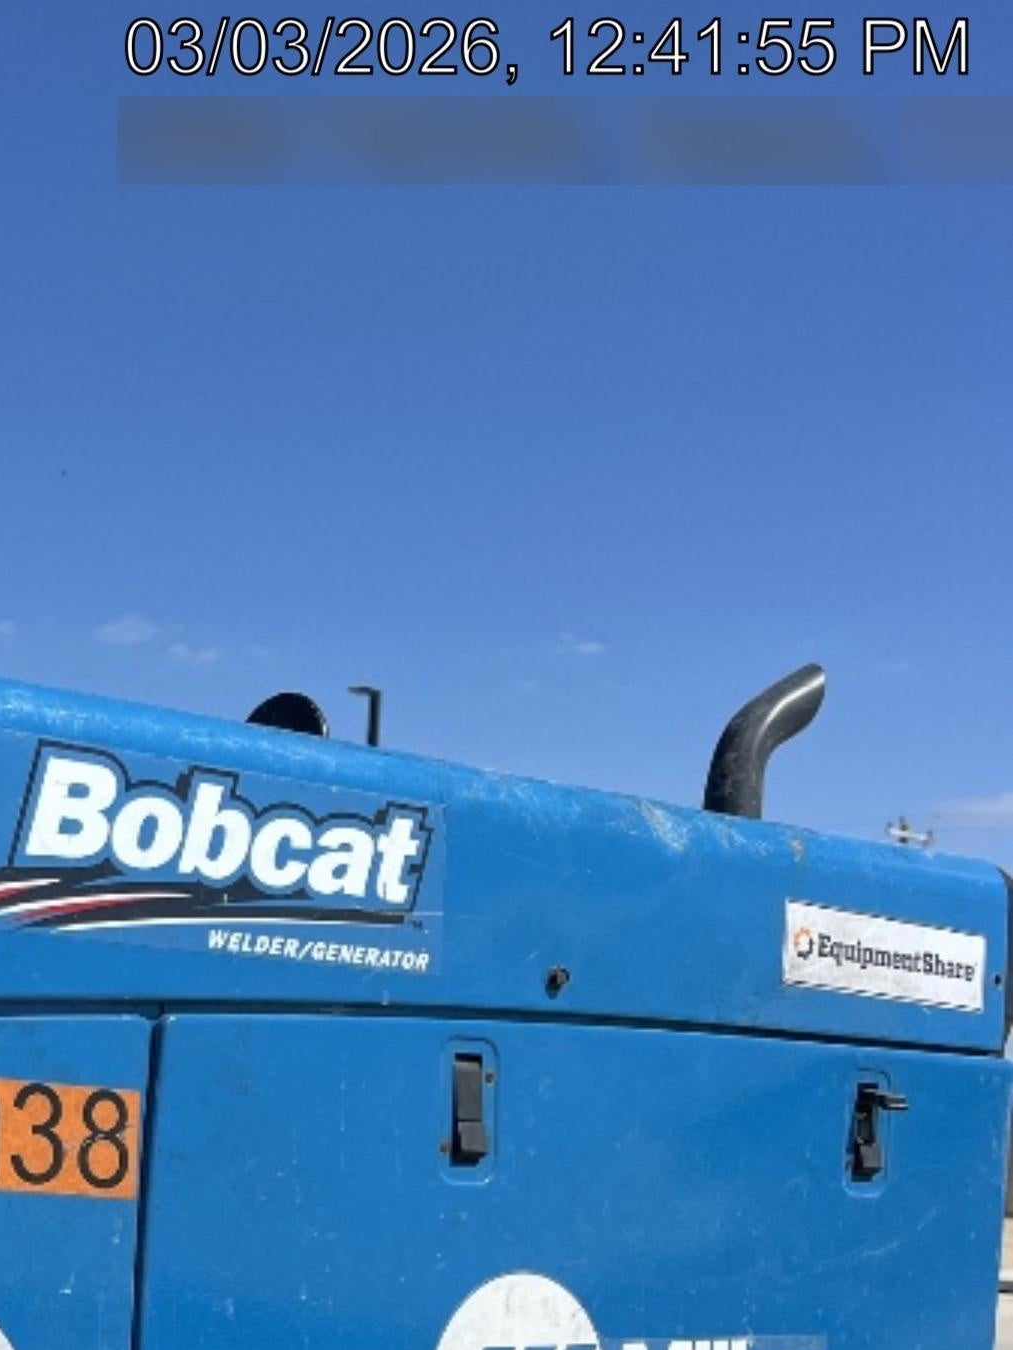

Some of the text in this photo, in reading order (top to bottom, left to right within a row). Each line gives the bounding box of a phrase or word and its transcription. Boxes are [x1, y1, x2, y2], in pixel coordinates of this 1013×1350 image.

[25, 755, 421, 906] Bobcat
[207, 927, 430, 971] WELDER/GENERATOR
[817, 932, 976, 981] EquipmentShare
